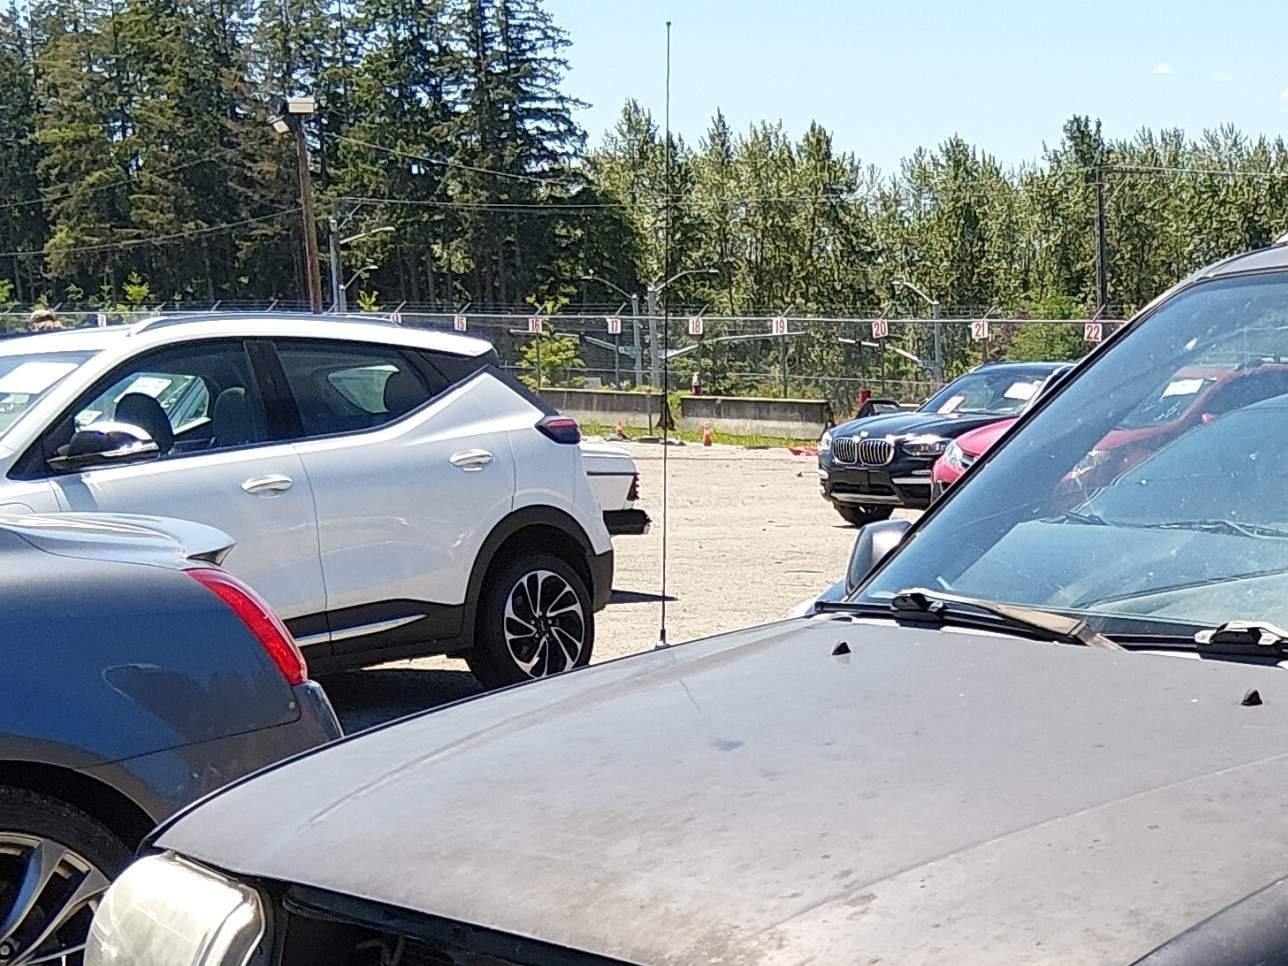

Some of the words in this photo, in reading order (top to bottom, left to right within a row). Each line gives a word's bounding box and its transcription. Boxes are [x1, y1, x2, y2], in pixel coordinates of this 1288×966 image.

[532, 319, 540, 332] 16
[692, 319, 701, 333] 18
[776, 319, 785, 333] 19
[874, 321, 886, 336] 20
[975, 322, 985, 337] 21
[1086, 325, 1100, 340] 22
